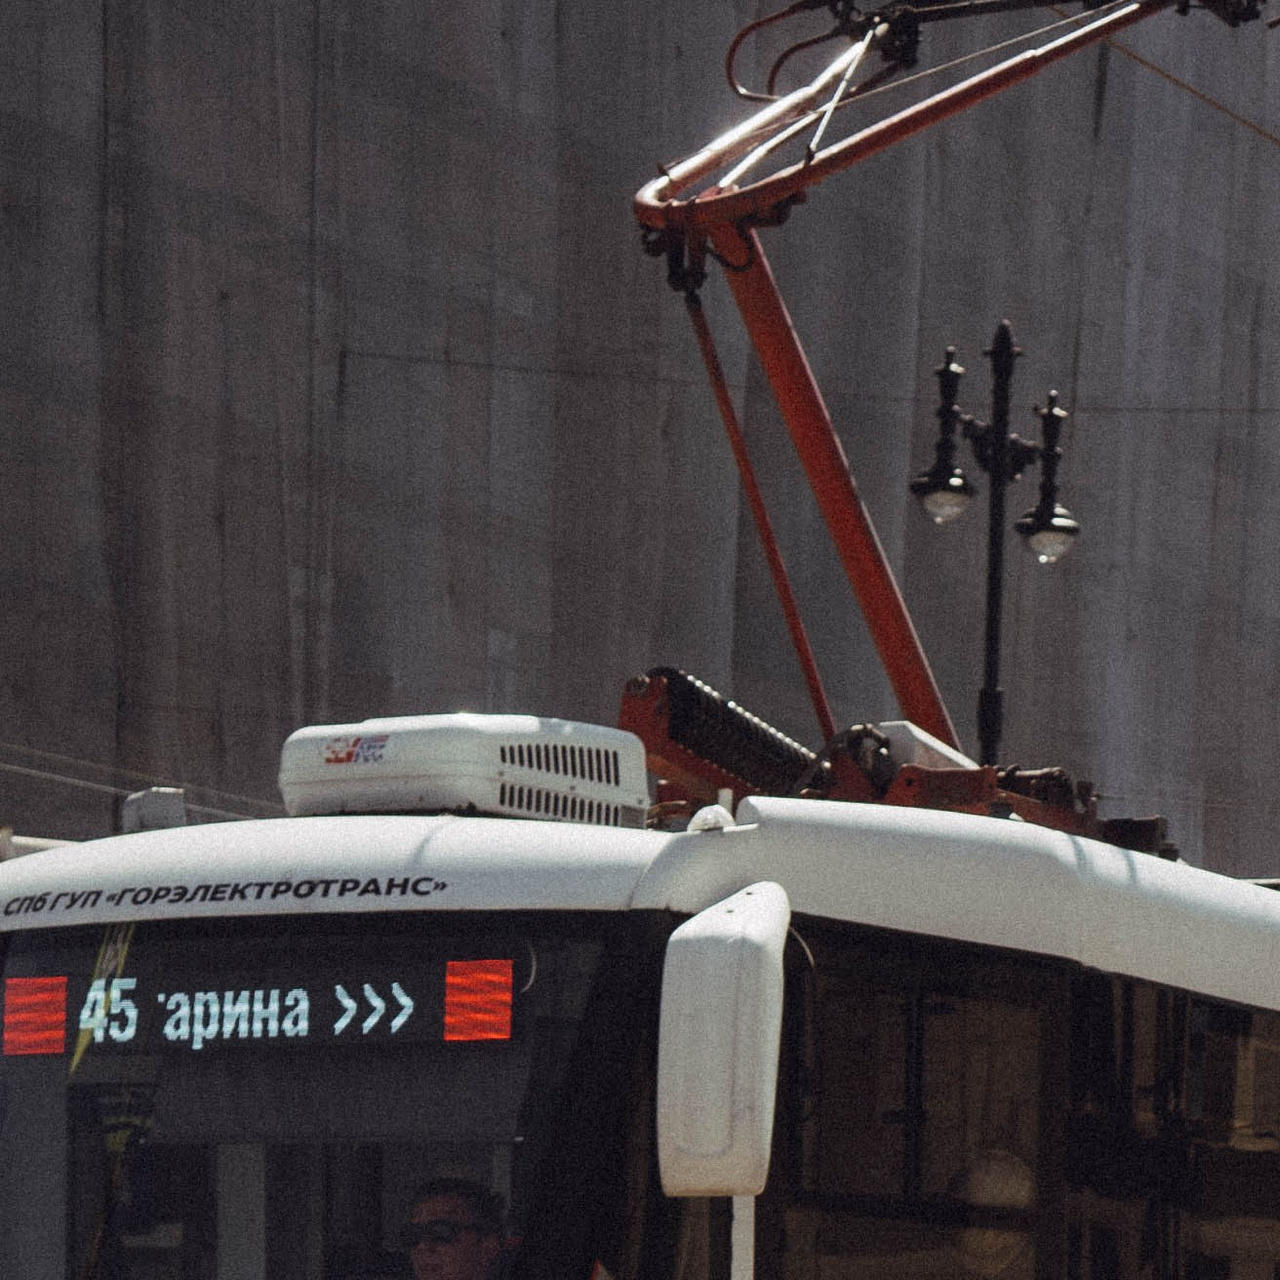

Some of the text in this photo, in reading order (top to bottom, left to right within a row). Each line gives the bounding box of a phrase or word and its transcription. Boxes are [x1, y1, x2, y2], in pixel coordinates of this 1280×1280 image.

[49, 889, 104, 911] ГУП
[105, 876, 448, 907] «ГОРЭЛЕКТРОТРАНС»
[78, 977, 310, 1051] 45 арина
